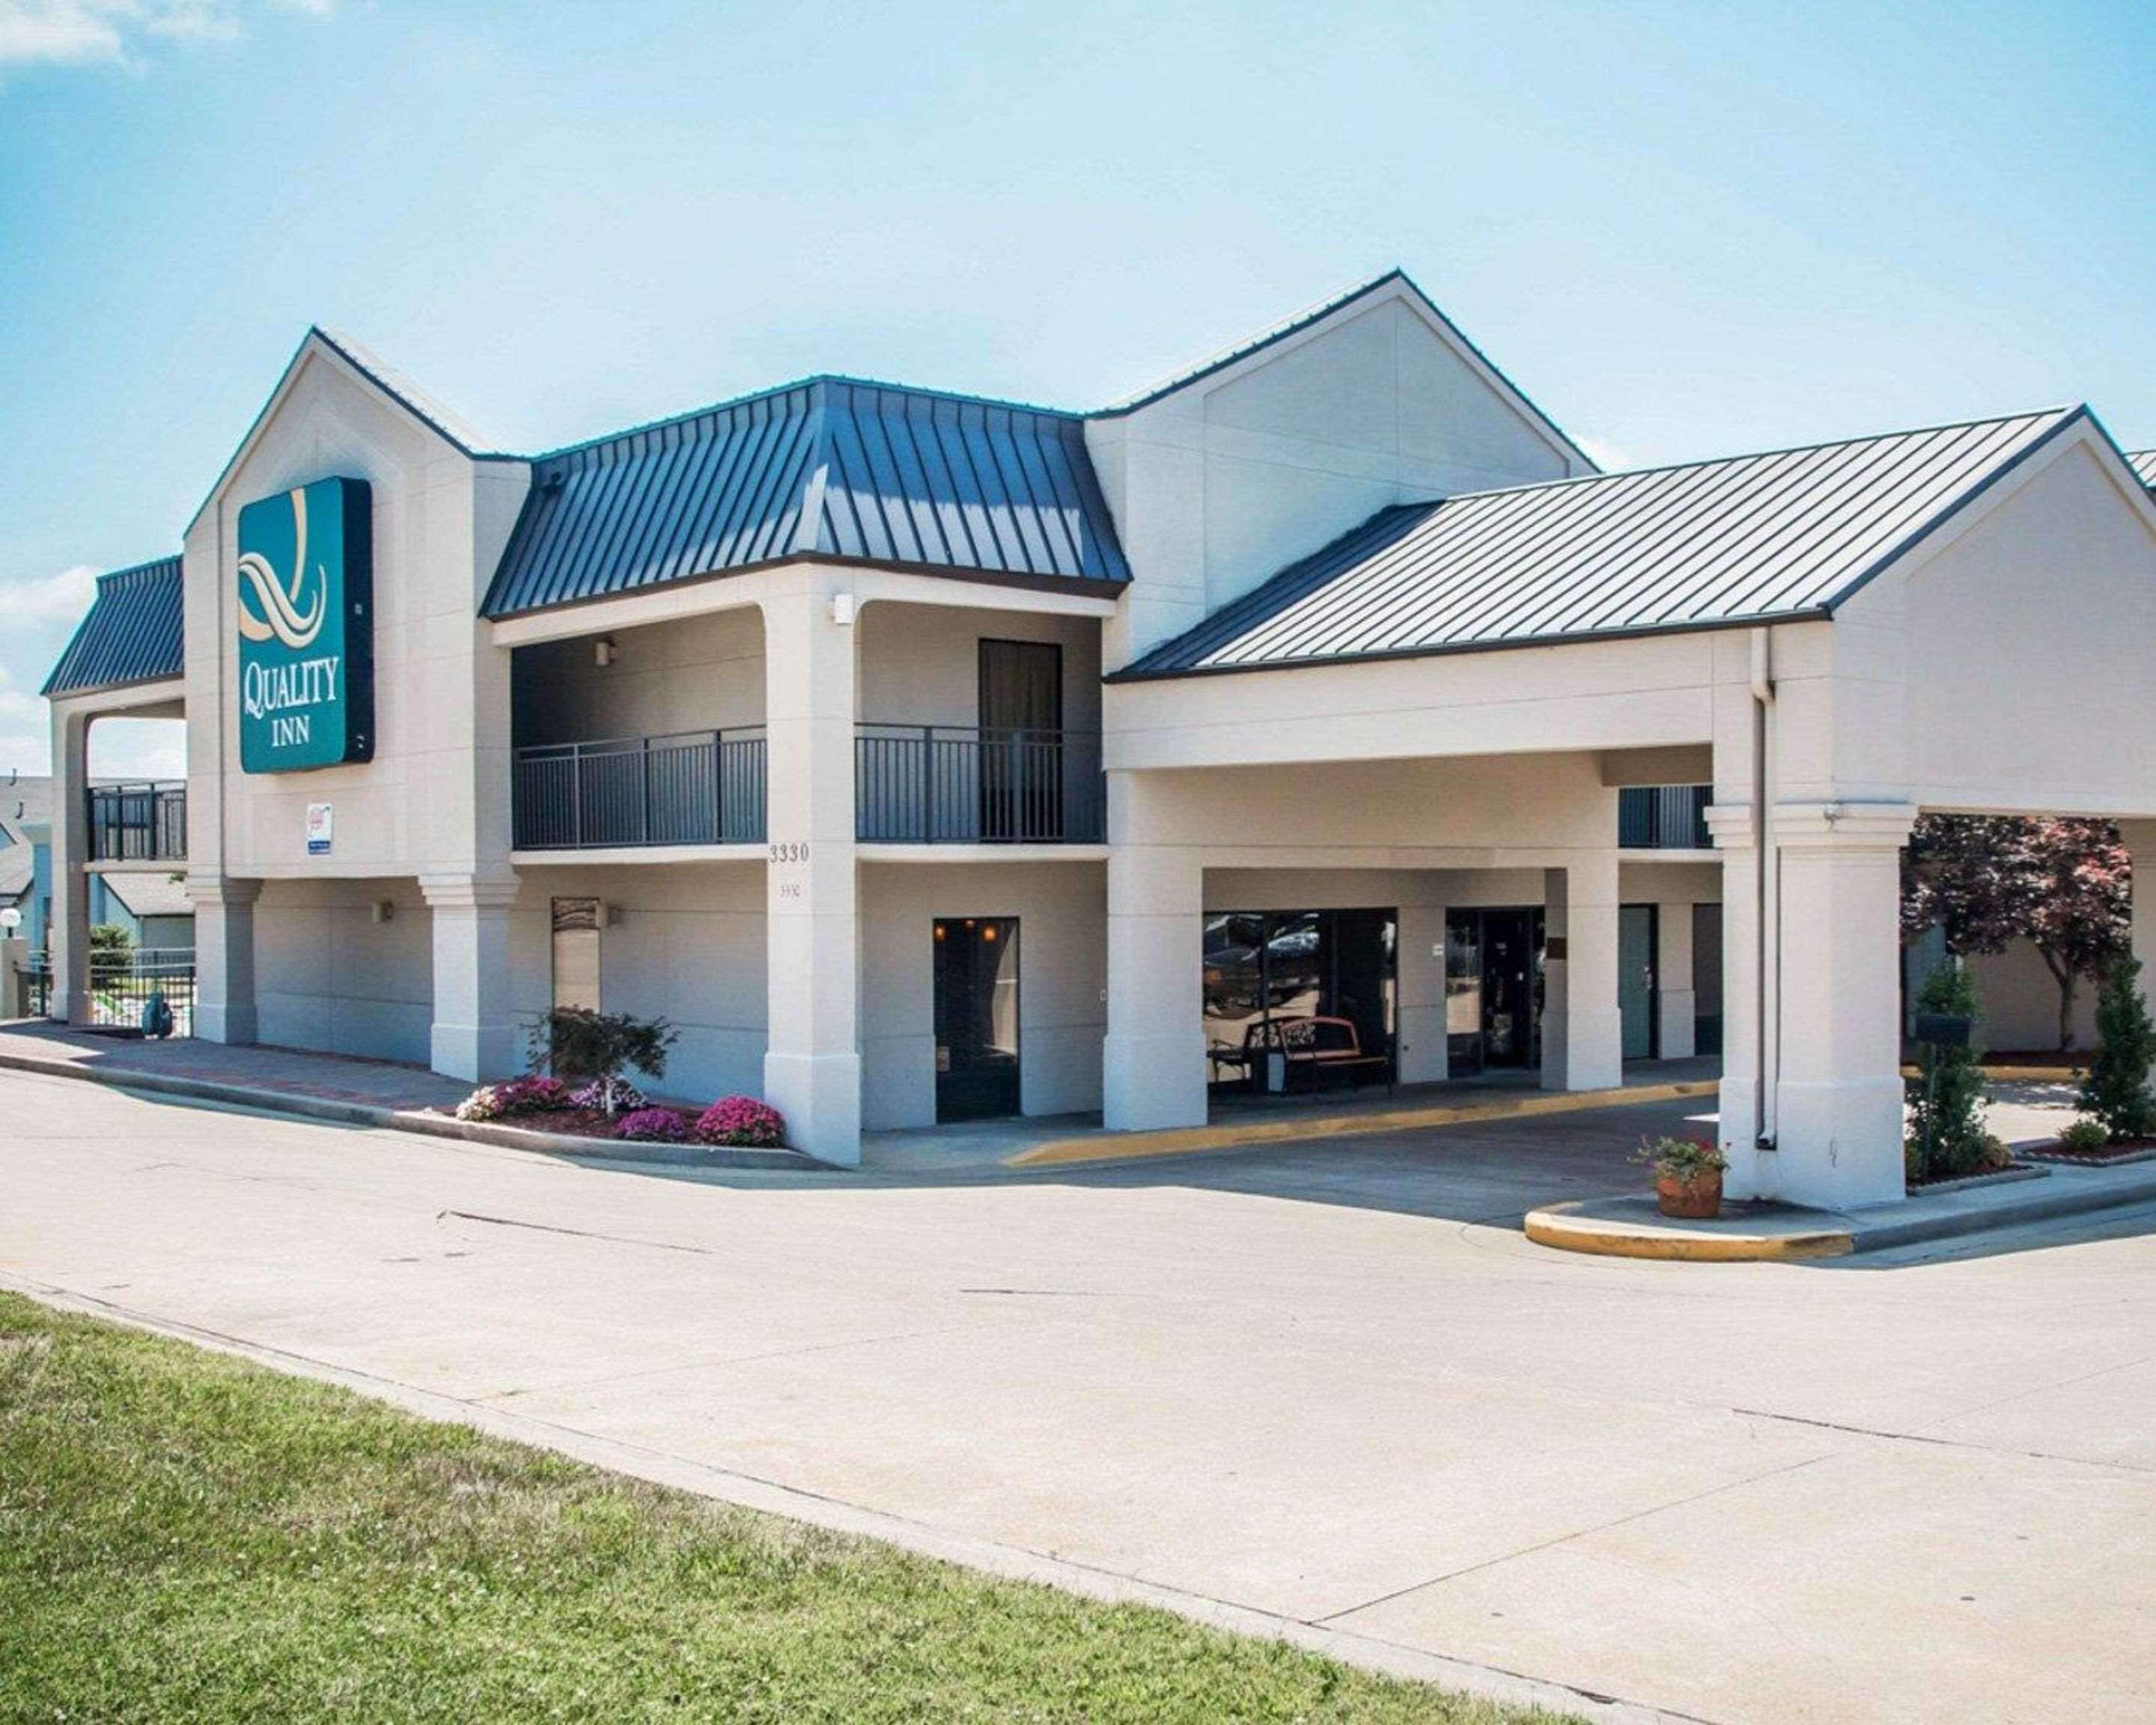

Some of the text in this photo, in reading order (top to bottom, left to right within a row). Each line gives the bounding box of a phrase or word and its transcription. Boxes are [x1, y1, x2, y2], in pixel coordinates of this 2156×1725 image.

[246, 657, 339, 719] QUALITY
[272, 715, 310, 747] INN
[770, 843, 809, 862] 3330
